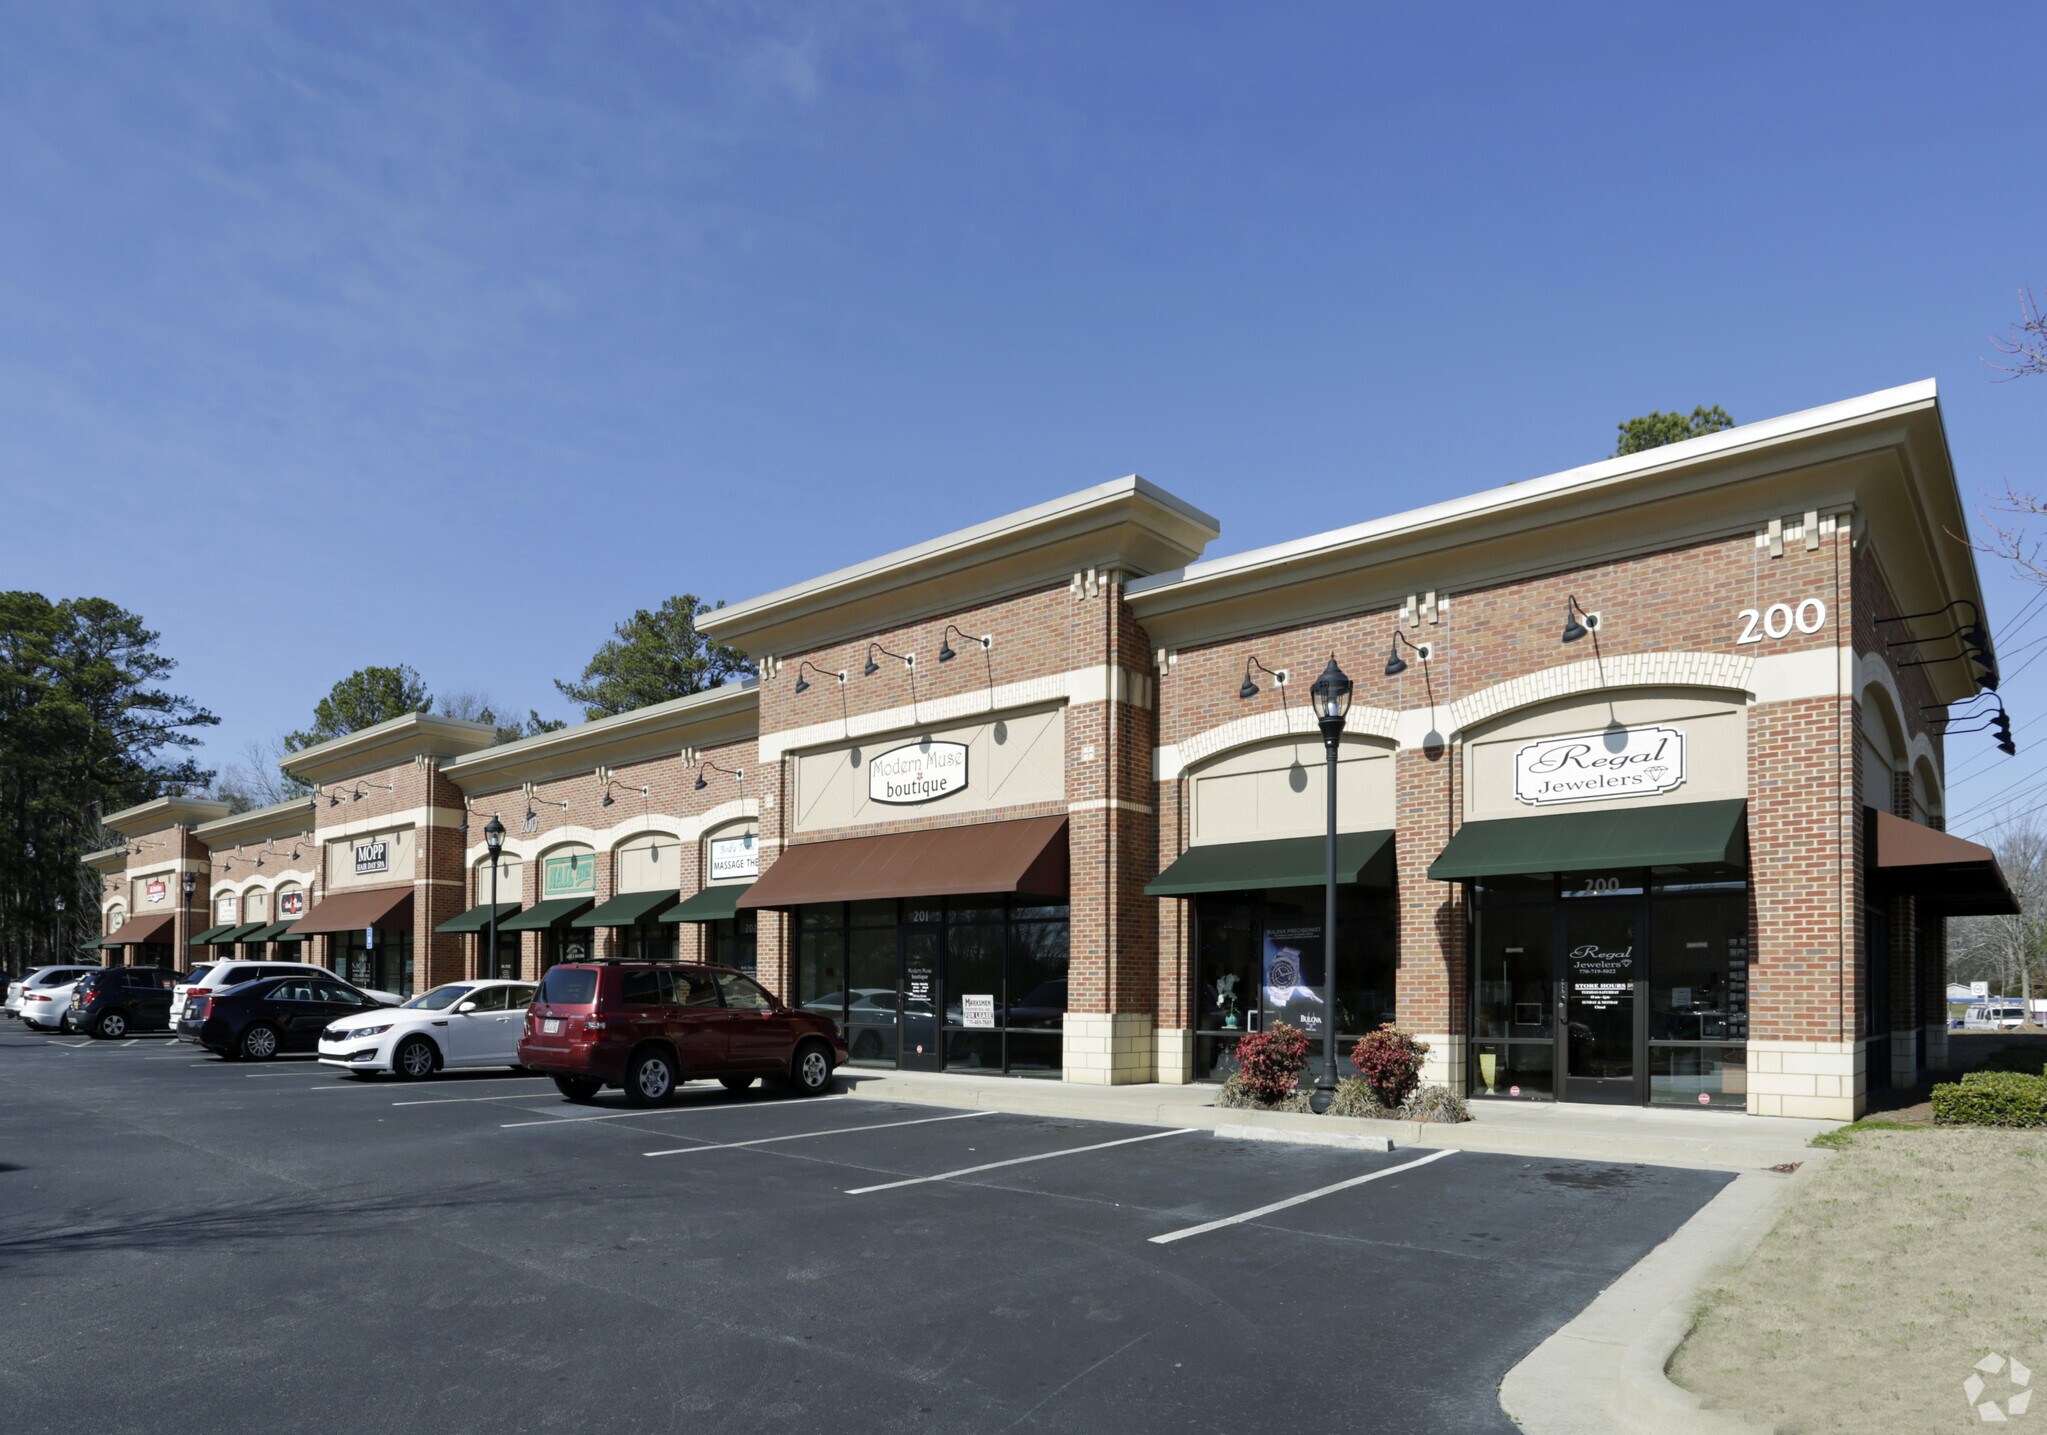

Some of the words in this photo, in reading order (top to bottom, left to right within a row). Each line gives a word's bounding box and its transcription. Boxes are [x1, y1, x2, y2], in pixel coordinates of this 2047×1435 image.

[1736, 598, 1826, 645] 200
[873, 758, 922, 777] Modern
[926, 752, 963, 770] Muse
[1528, 738, 1669, 774] Regal
[886, 778, 947, 797] boutique
[1538, 774, 1643, 794] Jewelers
[358, 844, 384, 861] MOPP
[357, 863, 367, 871] HAIR
[367, 861, 377, 870] DAY
[377, 860, 385, 869] SPA
[714, 859, 744, 870] MASSAGE
[1585, 877, 1620, 894] 200
[913, 910, 929, 922] 201
[1569, 944, 1632, 960] Regal
[1300, 1014, 1322, 1024] BULOVA
